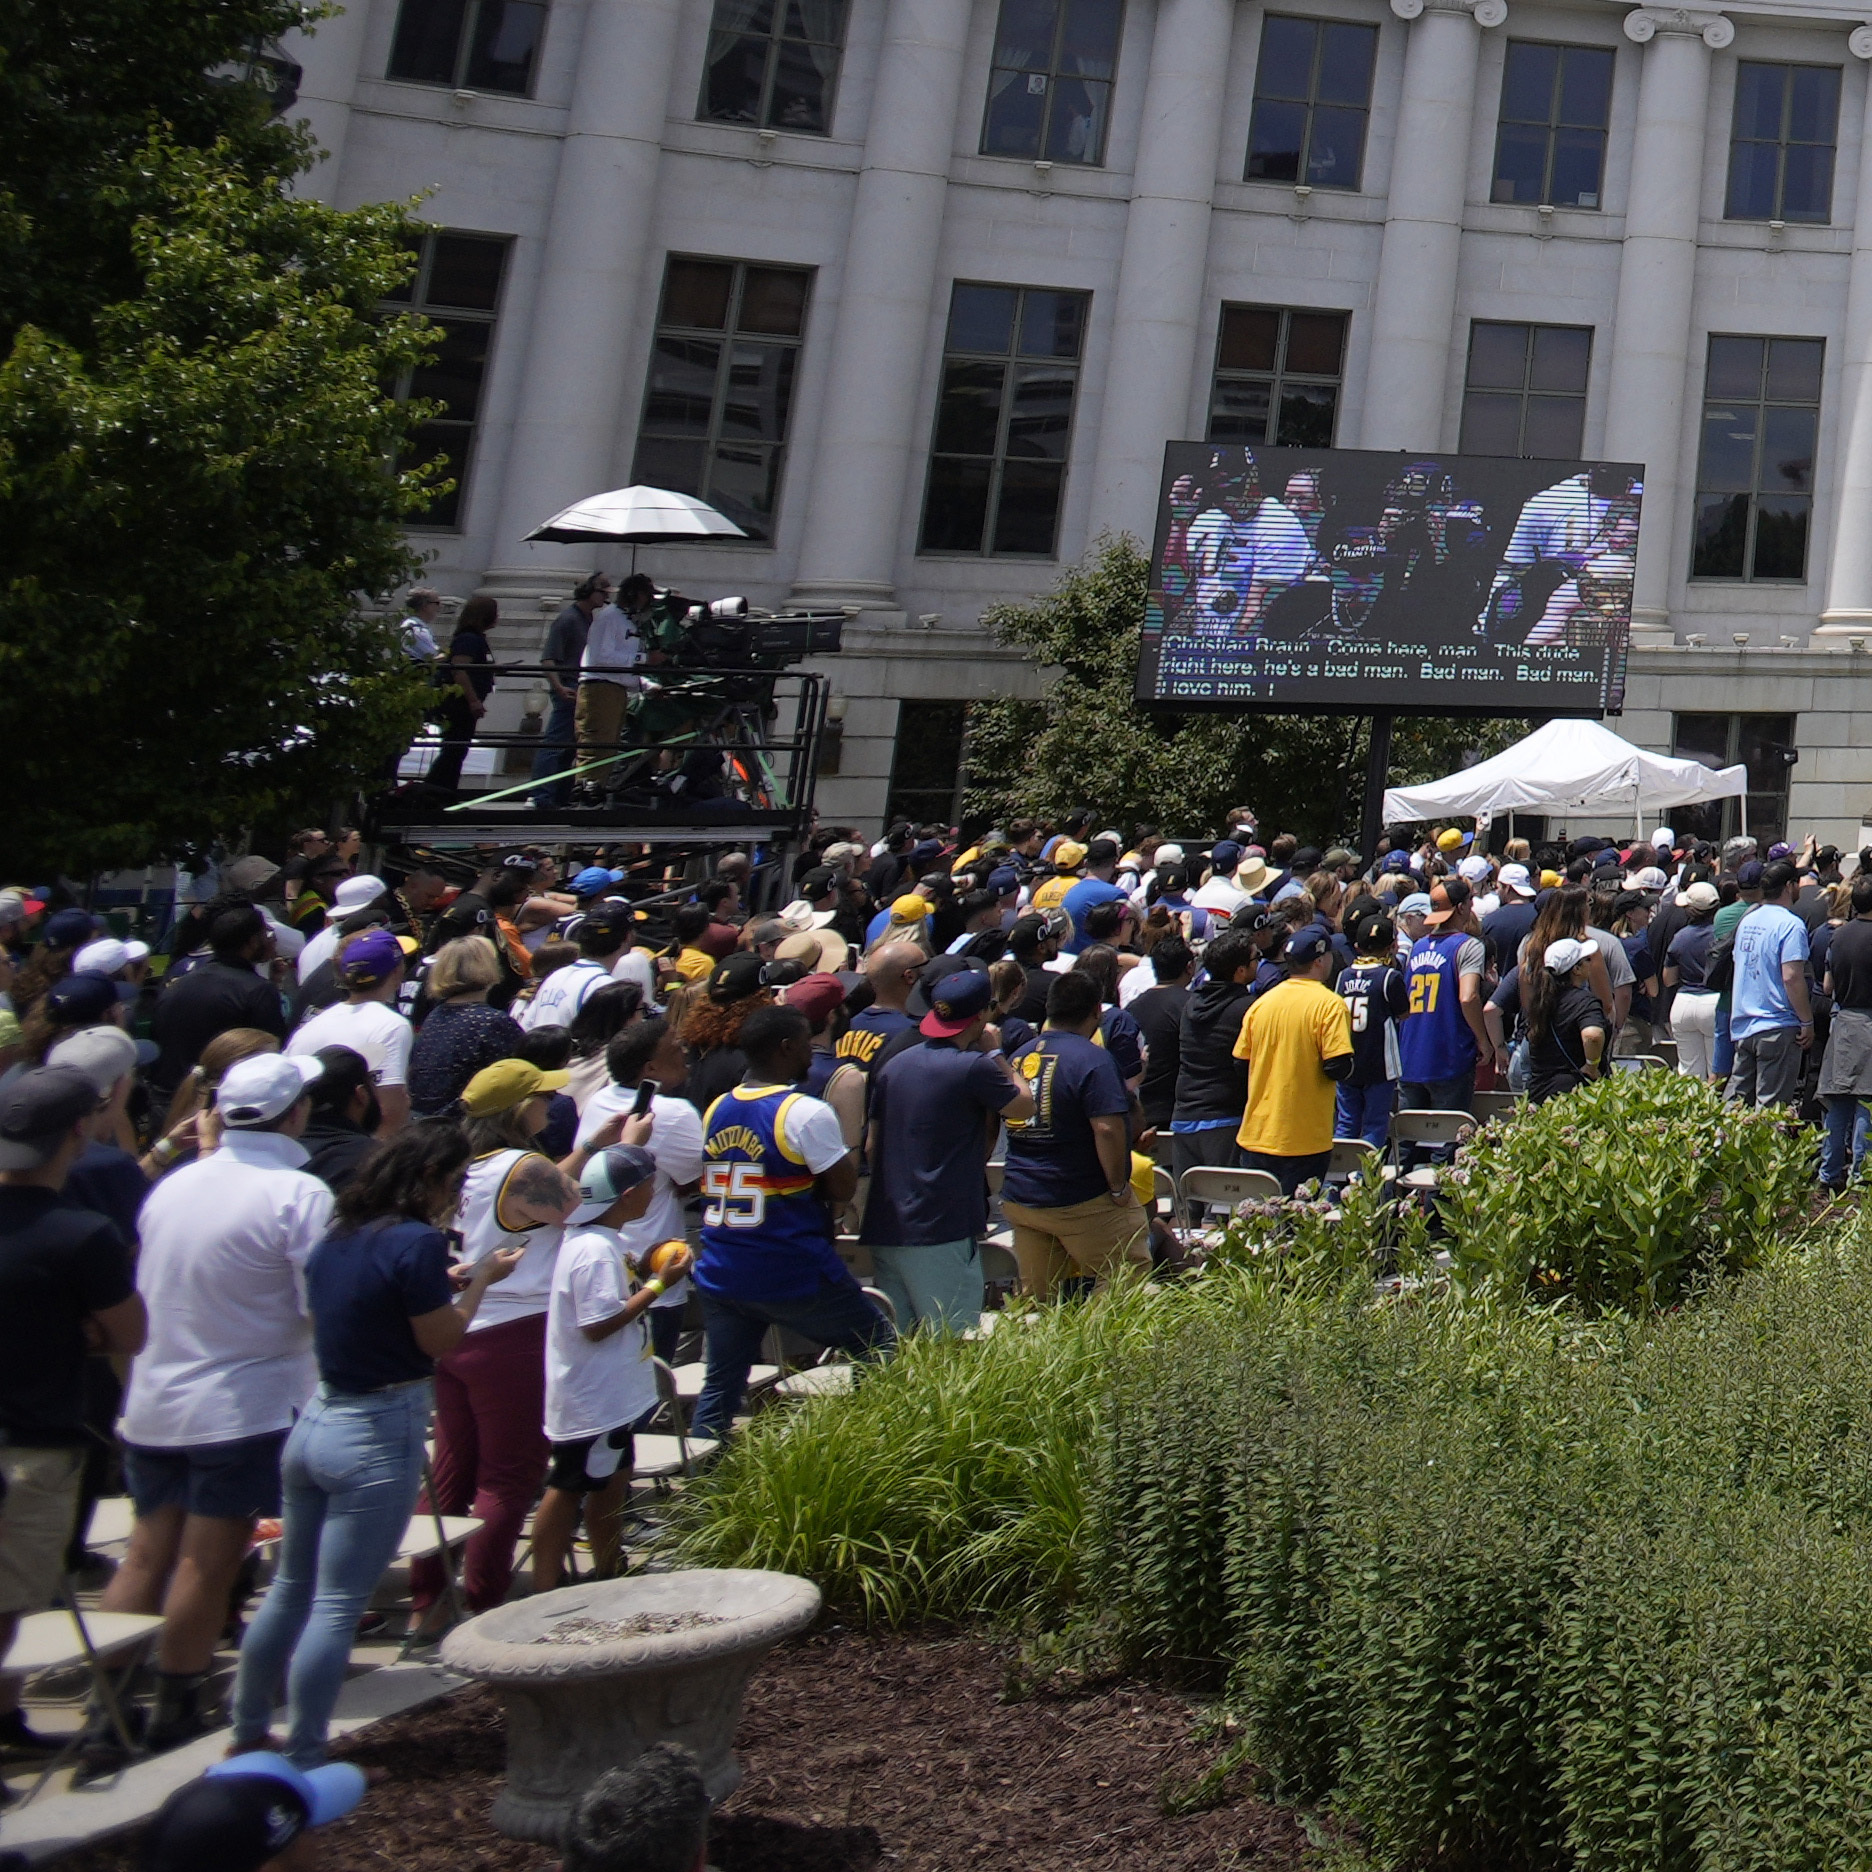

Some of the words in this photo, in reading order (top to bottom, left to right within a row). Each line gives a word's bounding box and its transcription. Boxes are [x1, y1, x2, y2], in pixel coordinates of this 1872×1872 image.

[1166, 635, 1249, 652] Christian
[1327, 639, 1382, 657] Come
[1494, 643, 1531, 660] This
[1536, 645, 1580, 661] dude
[1164, 656, 1206, 676] right
[1264, 658, 1302, 676] he's
[1307, 663, 1319, 677] a
[1324, 660, 1359, 677] bad
[1364, 664, 1408, 679] man.
[1420, 662, 1456, 679] Bad
[1461, 666, 1504, 681] man.
[1516, 664, 1552, 682] Bad
[1556, 668, 1599, 683] man.
[1173, 681, 1212, 695] love
[1217, 681, 1257, 696] him.
[1410, 950, 1447, 972] MURRAY
[1410, 973, 1441, 1014] 27
[704, 1125, 766, 1161] MUTOMBO
[703, 1161, 765, 1227] 55
